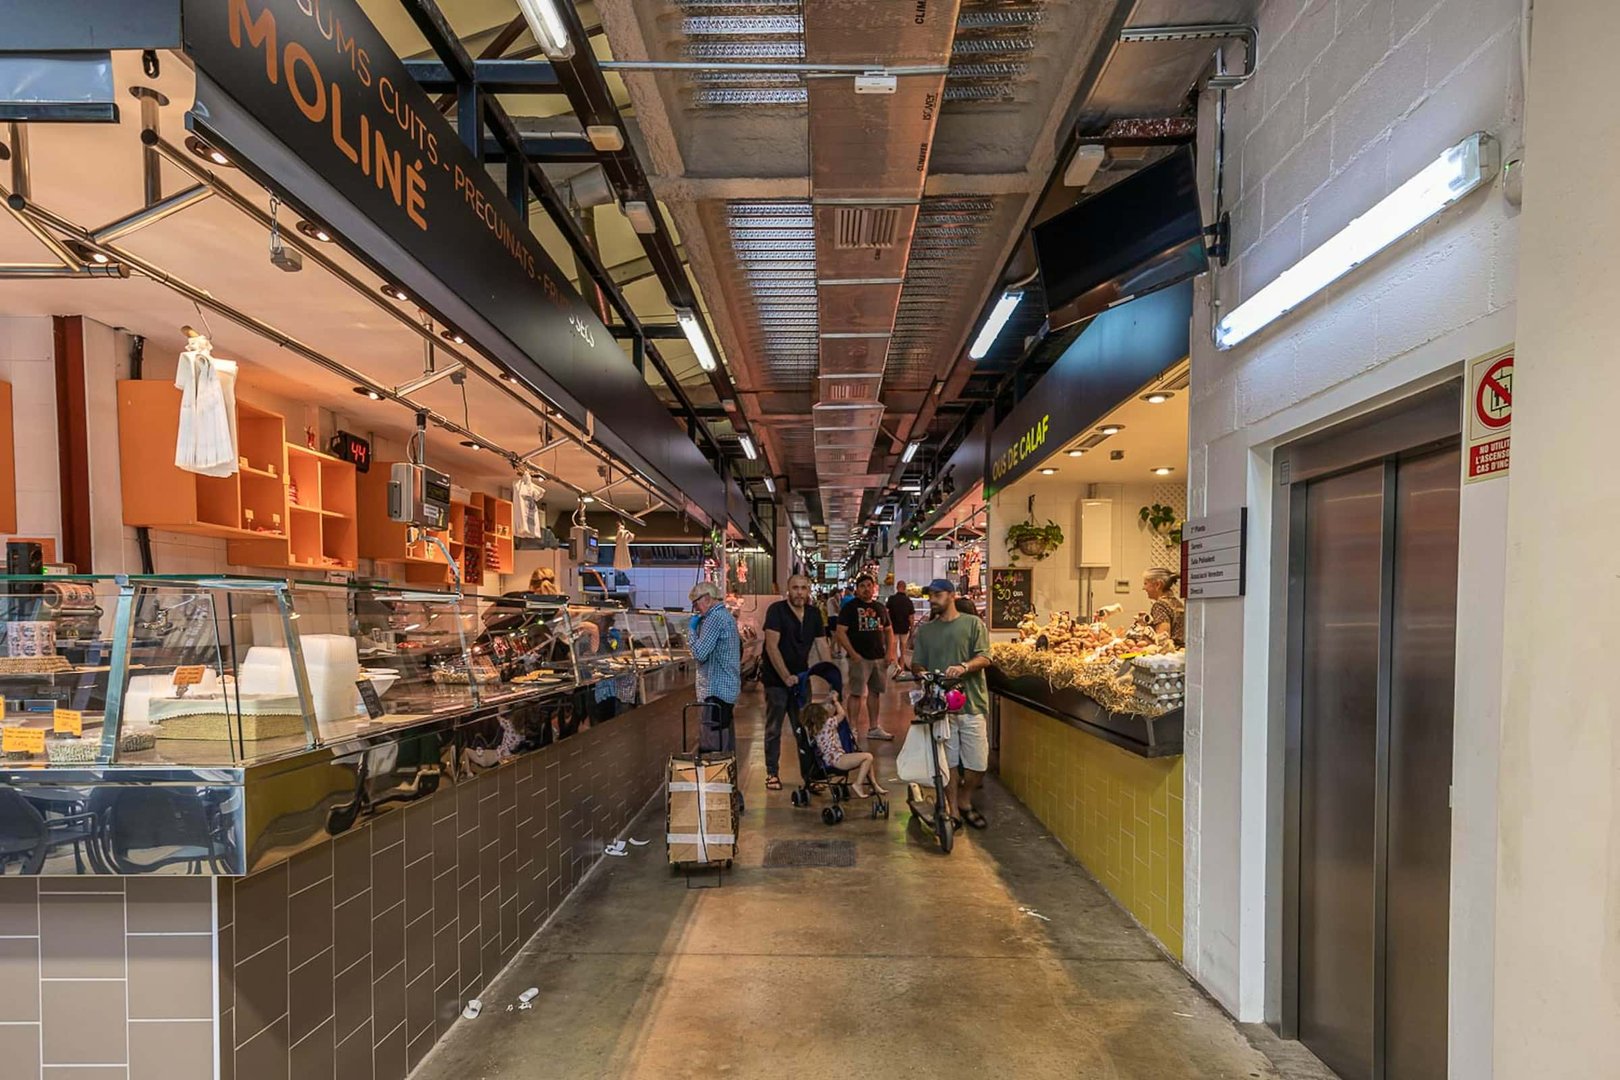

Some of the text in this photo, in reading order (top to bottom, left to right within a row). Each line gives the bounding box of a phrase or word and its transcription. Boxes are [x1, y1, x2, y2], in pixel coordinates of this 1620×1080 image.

[228, 0, 428, 231] MOLINÉ
[379, 76, 438, 166] CUITS
[455, 165, 535, 279] PRECUINATS
[351, 442, 366, 463] 44
[1008, 442, 1018, 470] DE
[1020, 414, 1049, 460] CALAF
[1479, 445, 1489, 454] NO
[1476, 463, 1489, 473] CAS
[997, 588, 1011, 601] 30
